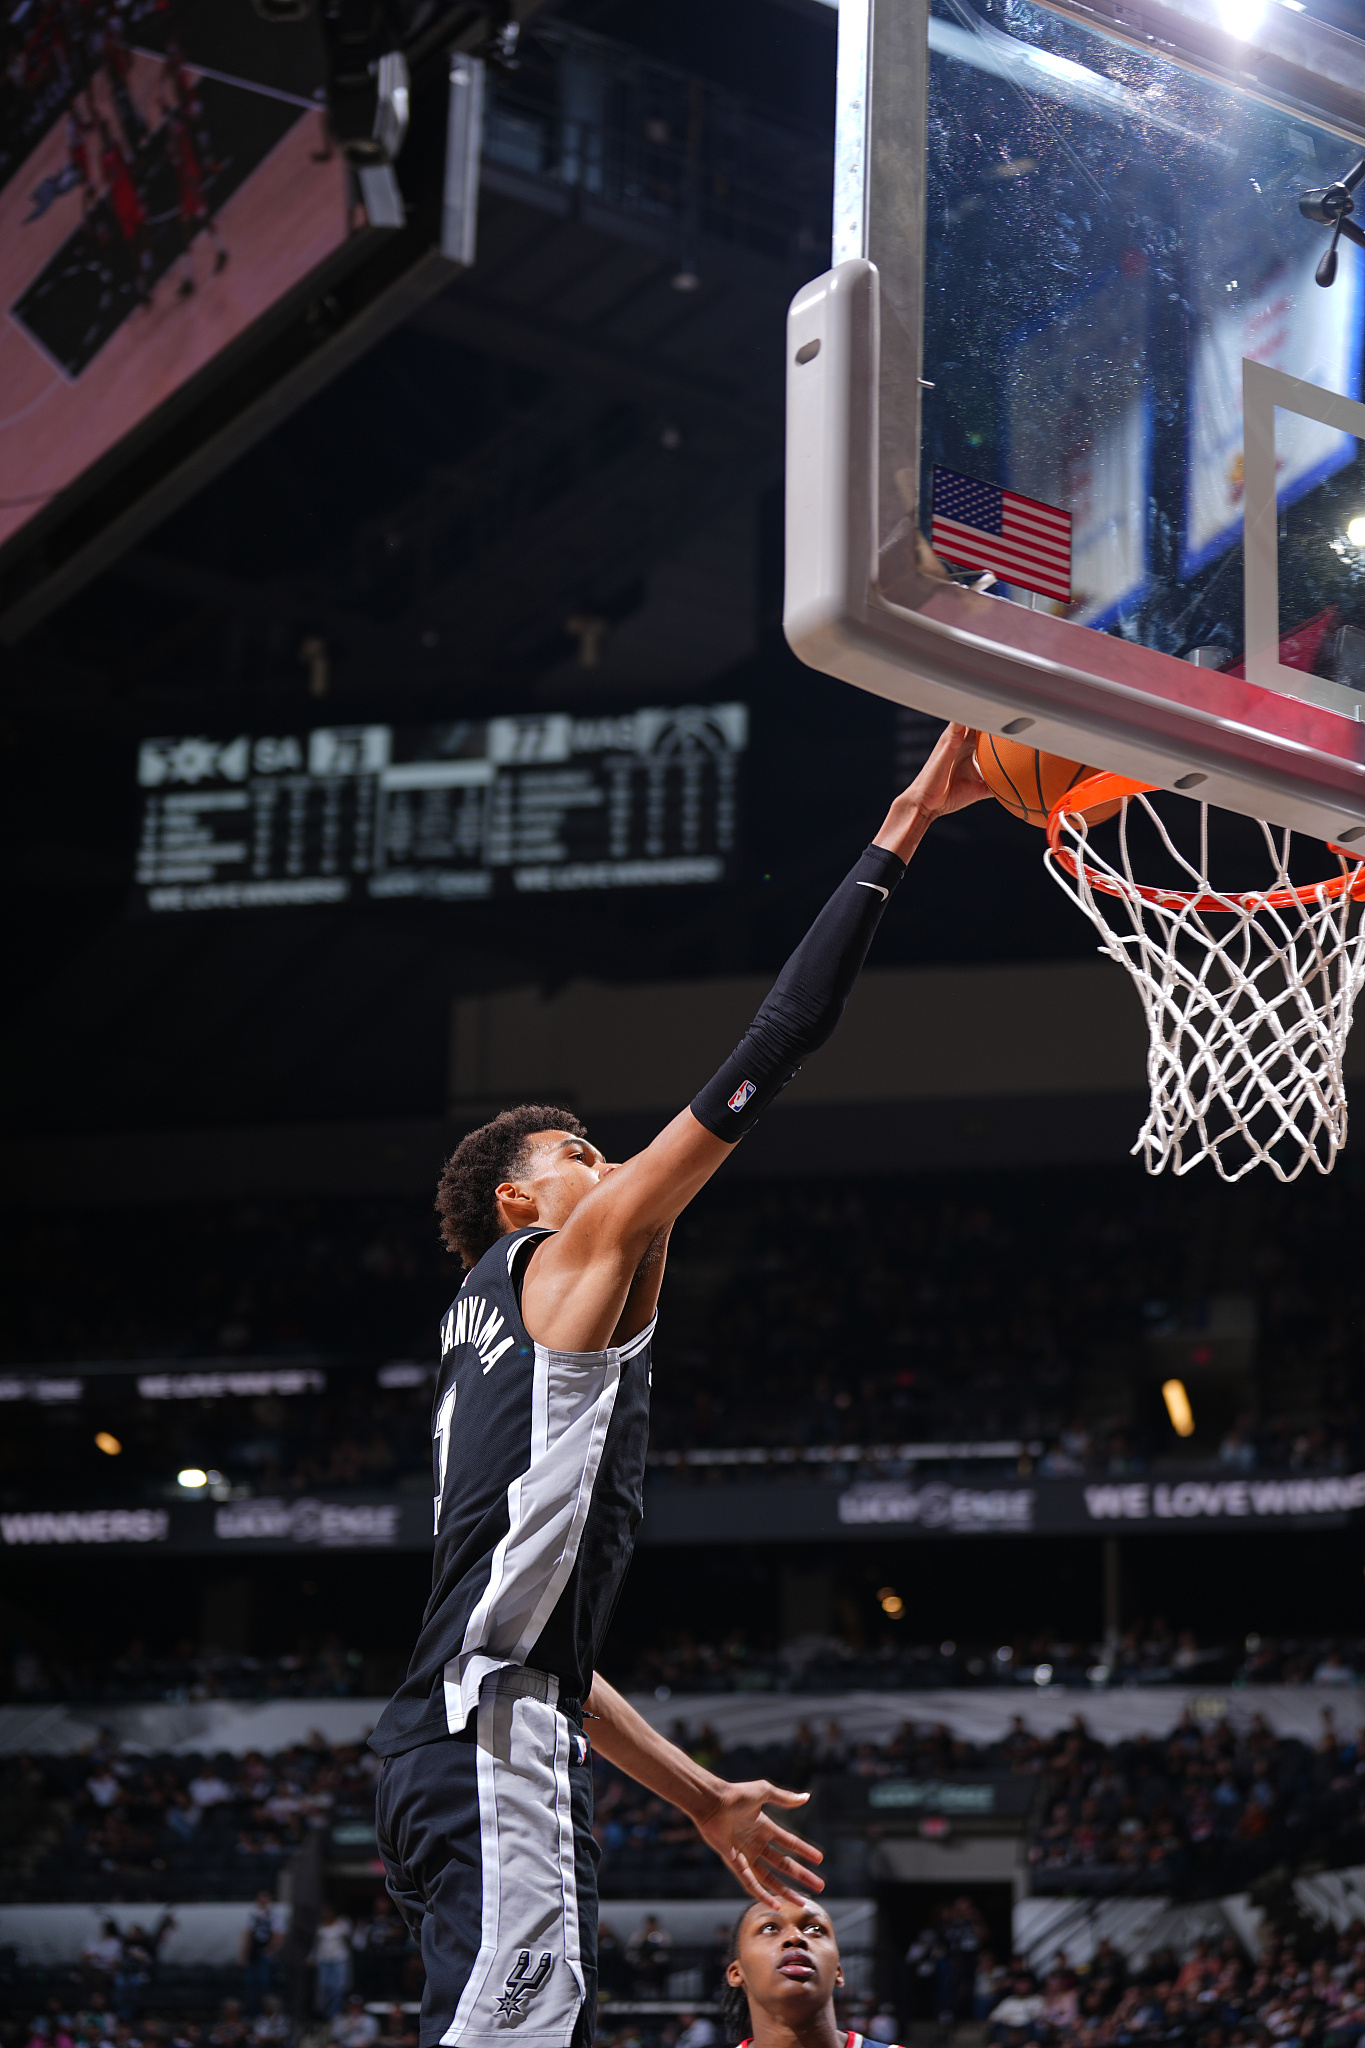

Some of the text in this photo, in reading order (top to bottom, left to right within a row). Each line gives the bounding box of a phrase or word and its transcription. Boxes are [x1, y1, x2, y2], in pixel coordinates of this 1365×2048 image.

[441, 1296, 515, 1376] ANYAMA
[1084, 1482, 1149, 1520] WE
[1153, 1481, 1248, 1518] LOVE
[1, 1508, 170, 1544] WINNERS!
